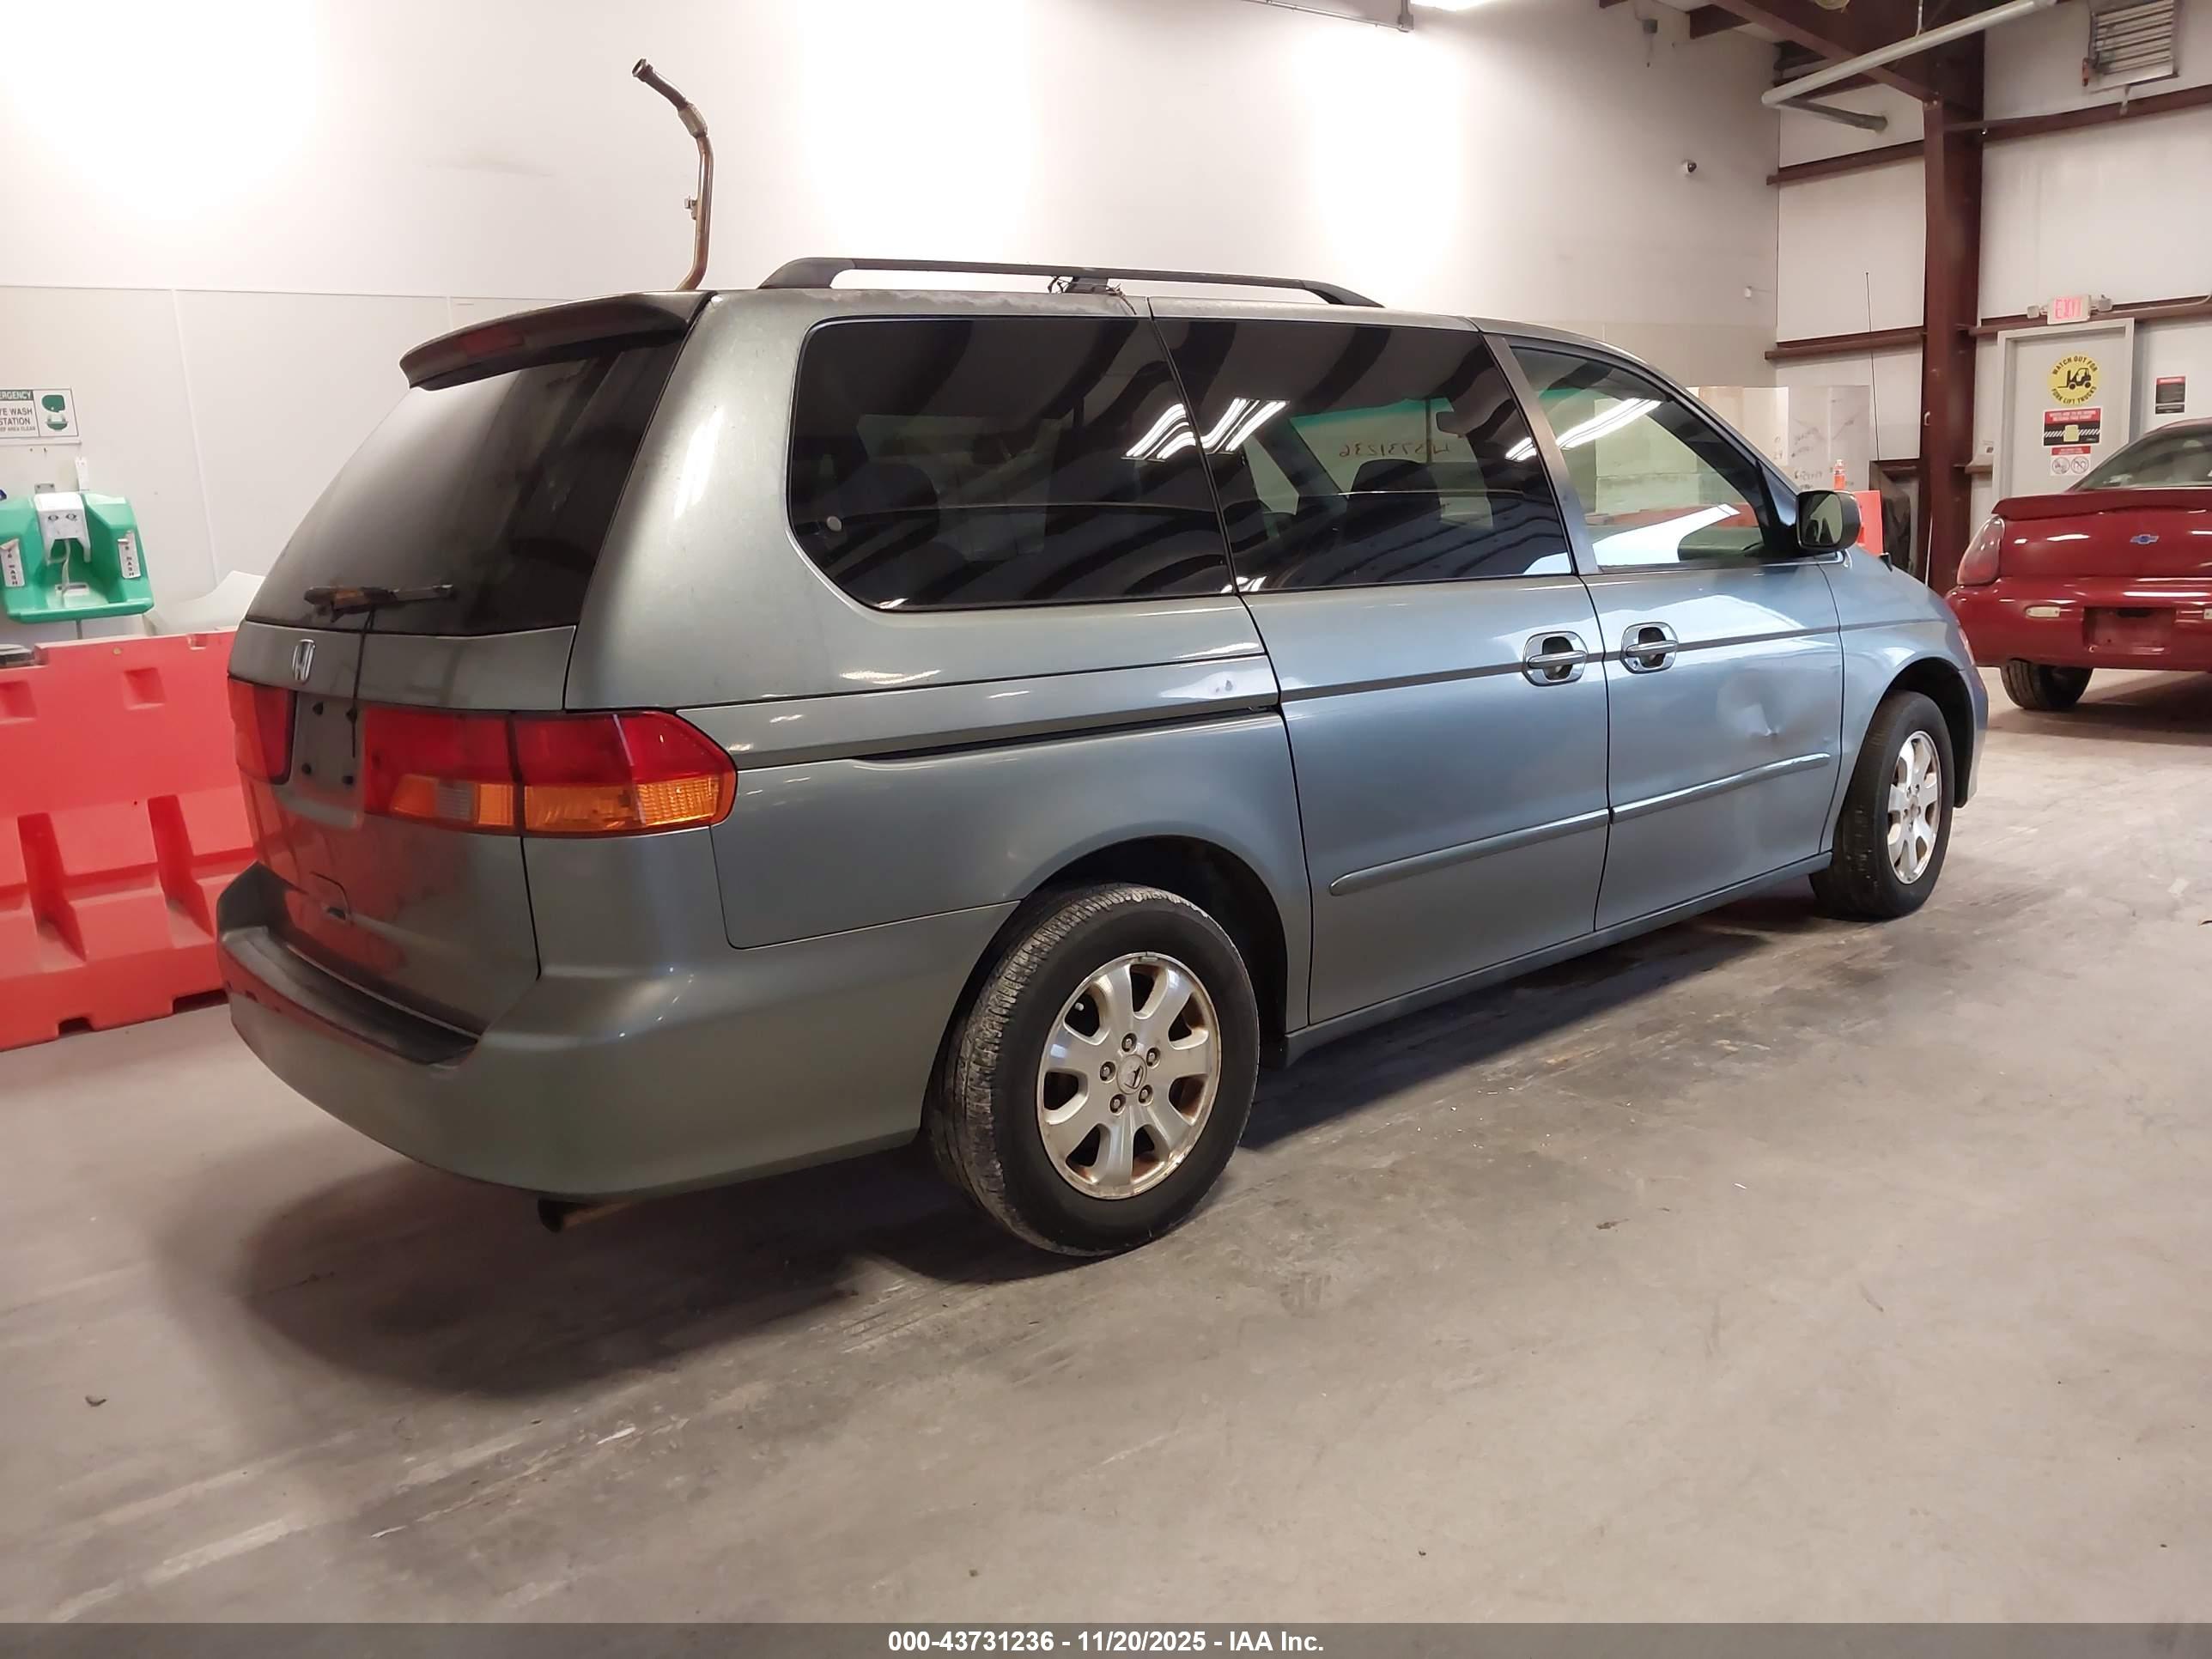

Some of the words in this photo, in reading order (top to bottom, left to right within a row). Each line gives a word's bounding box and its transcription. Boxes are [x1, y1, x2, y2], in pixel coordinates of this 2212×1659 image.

[2054, 298, 2081, 319] EXIT
[2052, 356, 2071, 374] WATCH
[2087, 360, 2098, 372] FOR
[2051, 388, 2063, 401] FORK
[2077, 386, 2096, 403] TRUCKS
[9, 407, 33, 416] WASH
[0, 417, 31, 426] STATION
